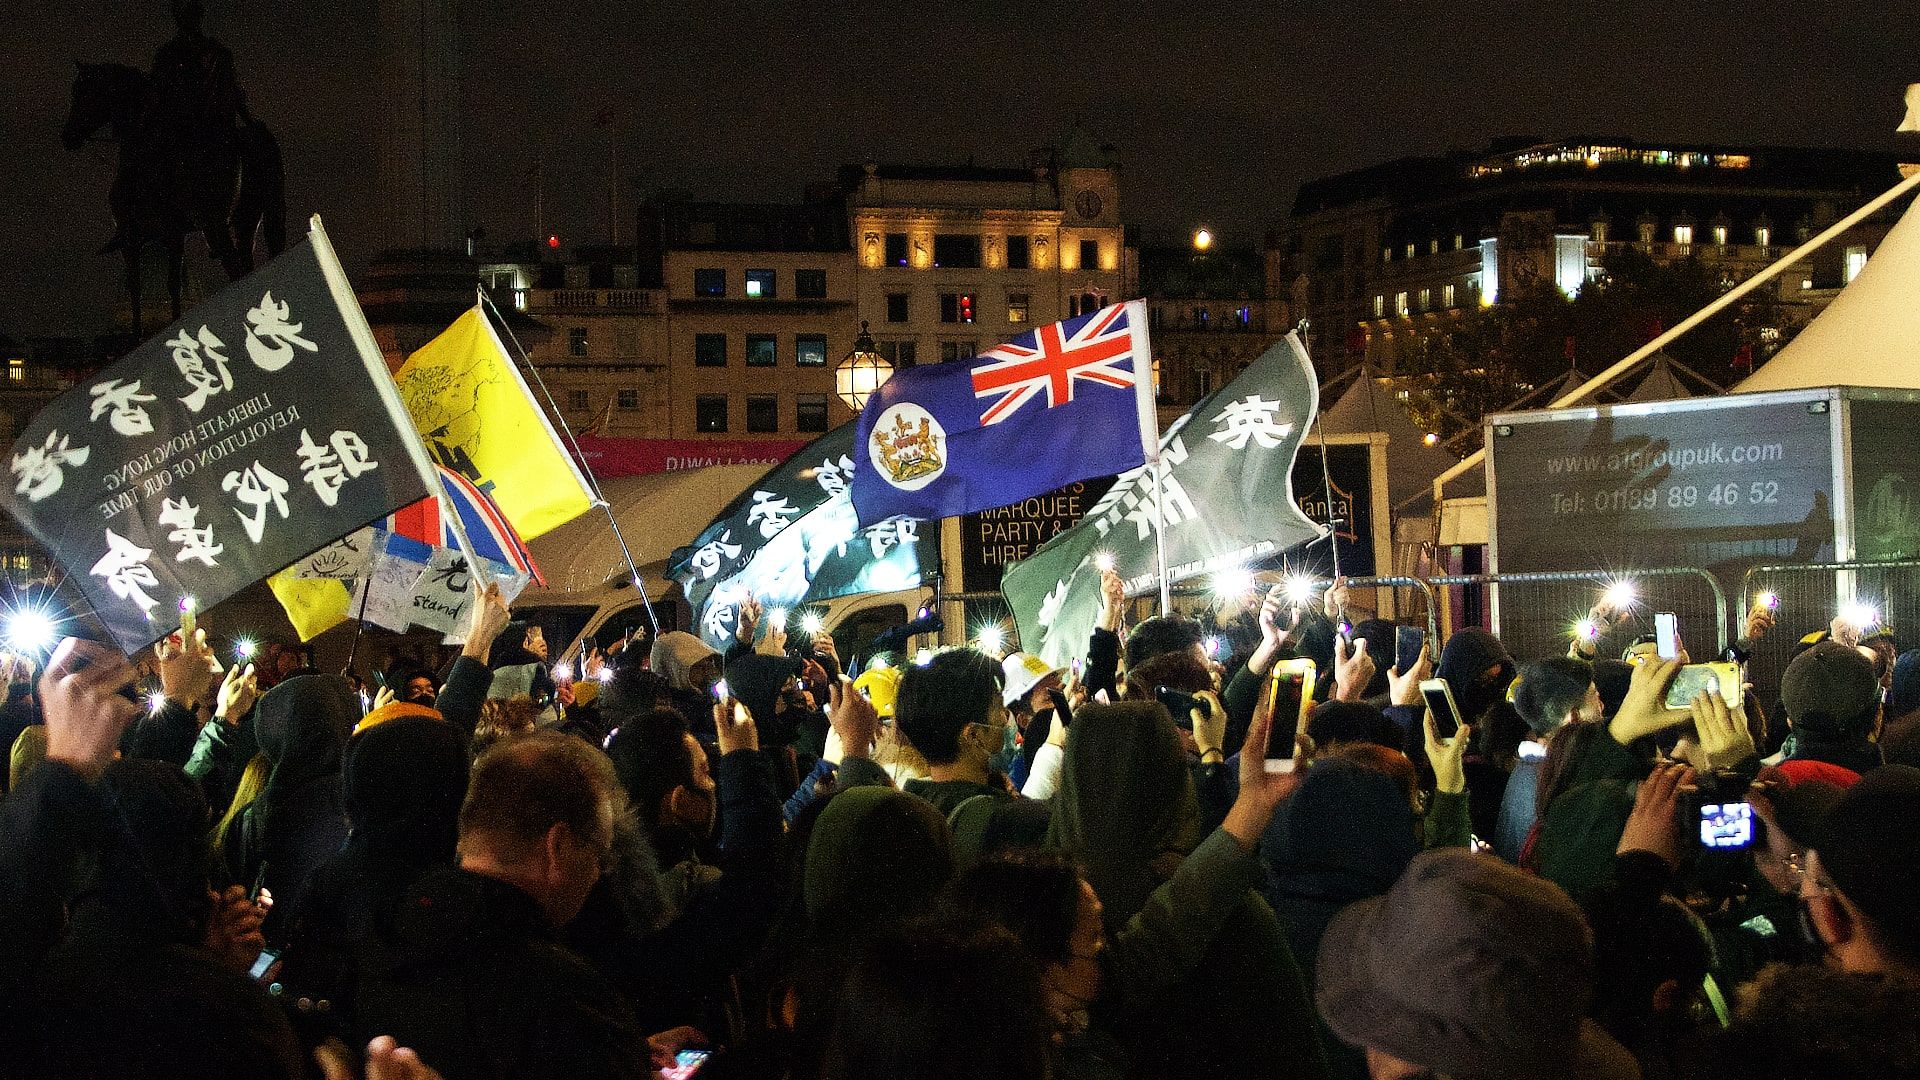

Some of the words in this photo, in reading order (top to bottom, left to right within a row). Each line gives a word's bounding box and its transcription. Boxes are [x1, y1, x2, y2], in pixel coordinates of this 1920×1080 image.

[1550, 492, 1585, 515] Tel:
[1667, 484, 1699, 509] 89
[1707, 481, 1740, 506] 46
[1748, 479, 1780, 505] 52
[981, 520, 1045, 542] PARTY
[431, 556, 468, 592] 光
[413, 594, 465, 620] stand
